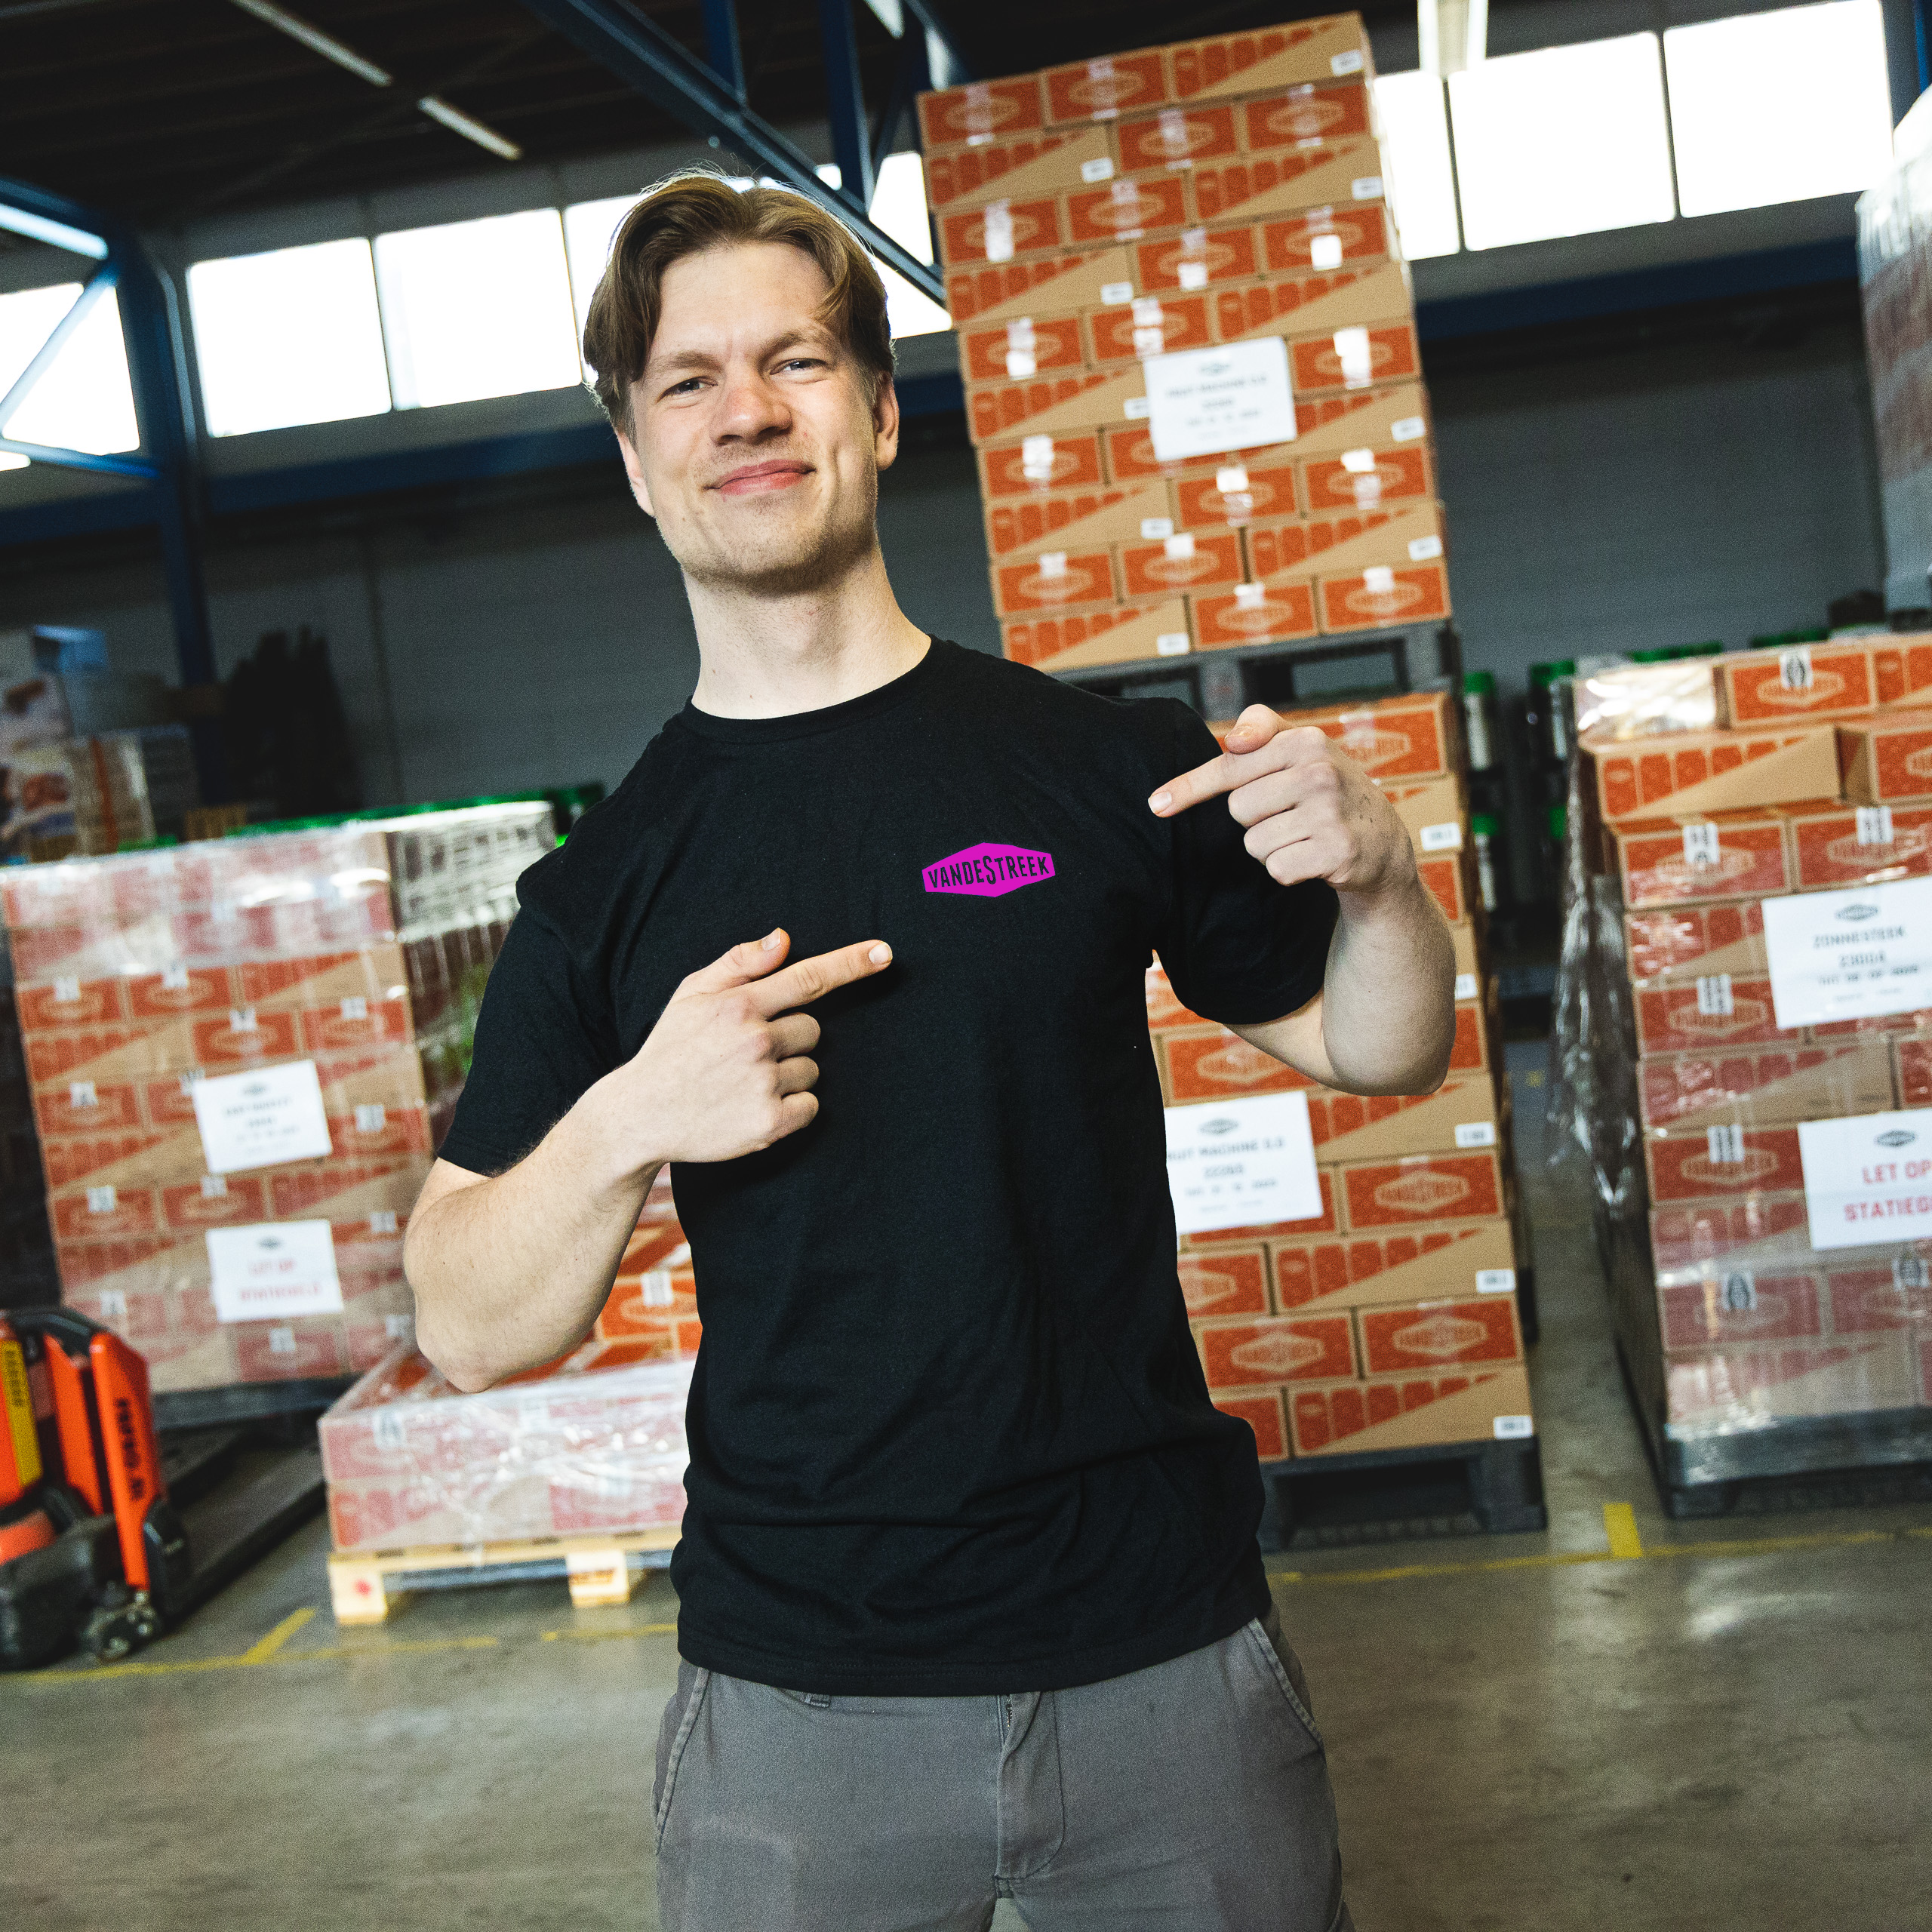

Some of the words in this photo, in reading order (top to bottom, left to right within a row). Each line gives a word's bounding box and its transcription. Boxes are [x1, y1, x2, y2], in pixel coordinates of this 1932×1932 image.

[928, 855, 1050, 888] VANDESTREEK
[1861, 1163, 1897, 1184] LET
[1904, 1159, 1932, 1180] OP
[1844, 1195, 1932, 1222] STATIEG
